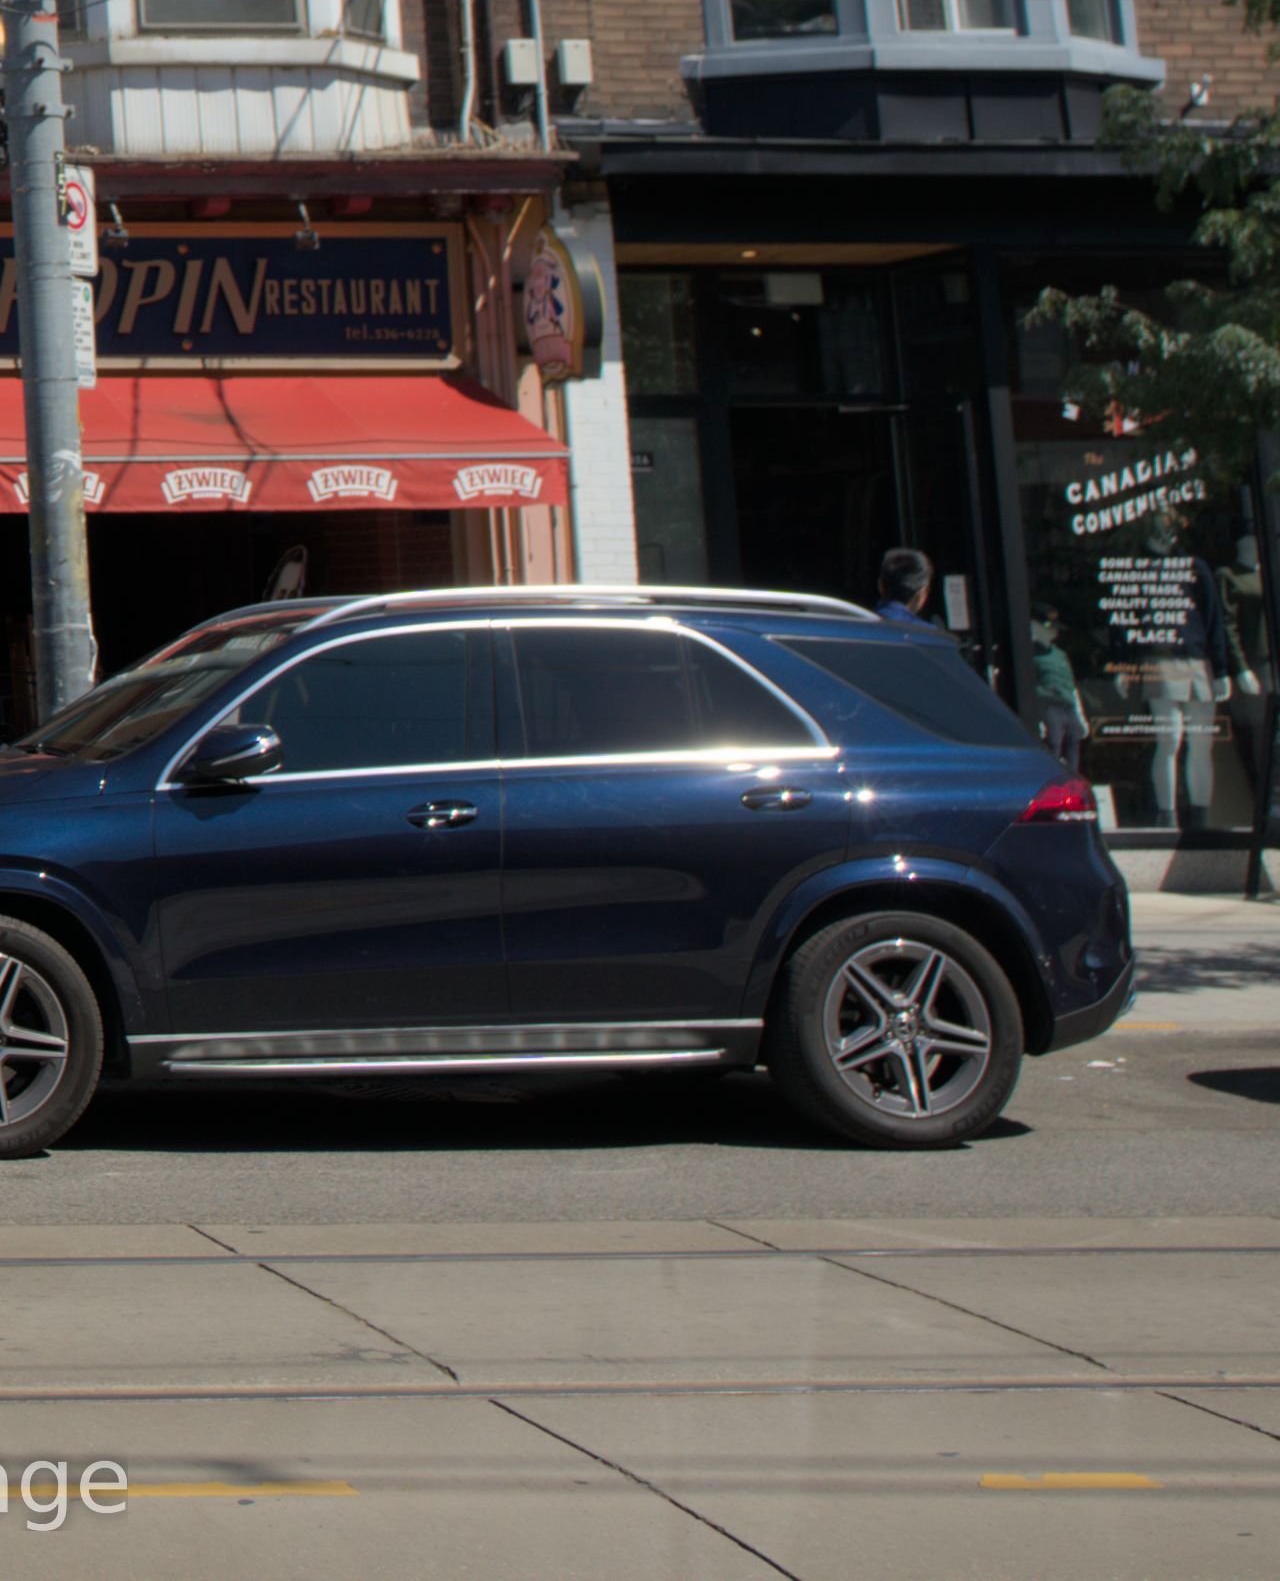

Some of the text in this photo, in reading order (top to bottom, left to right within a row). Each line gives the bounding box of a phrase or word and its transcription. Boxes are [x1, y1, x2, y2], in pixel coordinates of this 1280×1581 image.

[265, 278, 440, 316] RESTAURANT
[1065, 447, 1198, 505] CANADIAN
[1100, 556, 1134, 570] SOME
[1163, 556, 1195, 570] BEST
[1098, 570, 1158, 583] CANADIAN
[1111, 583, 1140, 596] FAIR
[1098, 596, 1149, 610] QUALITY
[1109, 610, 1140, 626] ALL
[1153, 610, 1187, 626] ONE
[1126, 628, 1184, 645] PLACE.
